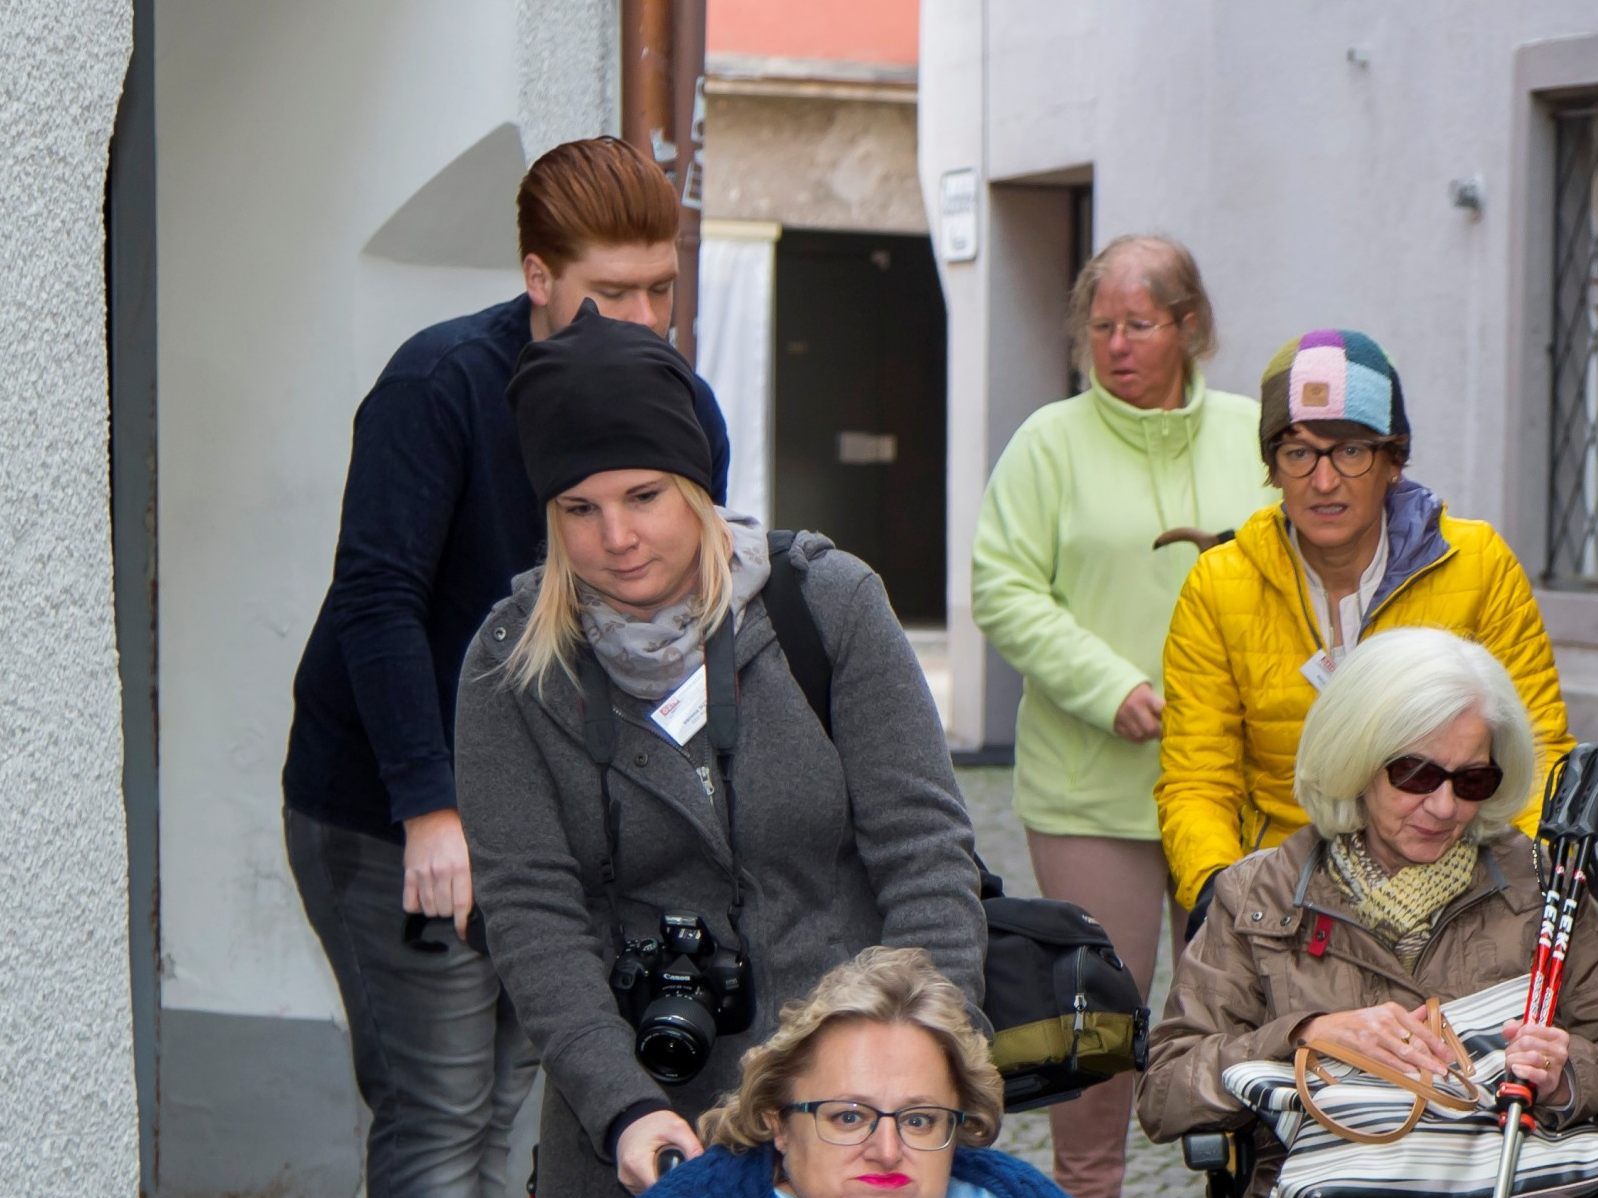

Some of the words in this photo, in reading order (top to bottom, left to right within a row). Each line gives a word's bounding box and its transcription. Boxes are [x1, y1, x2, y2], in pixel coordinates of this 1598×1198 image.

[1538, 889, 1560, 947] LEKI
[1552, 898, 1577, 961] LEKI
[663, 973, 691, 981] Canon
